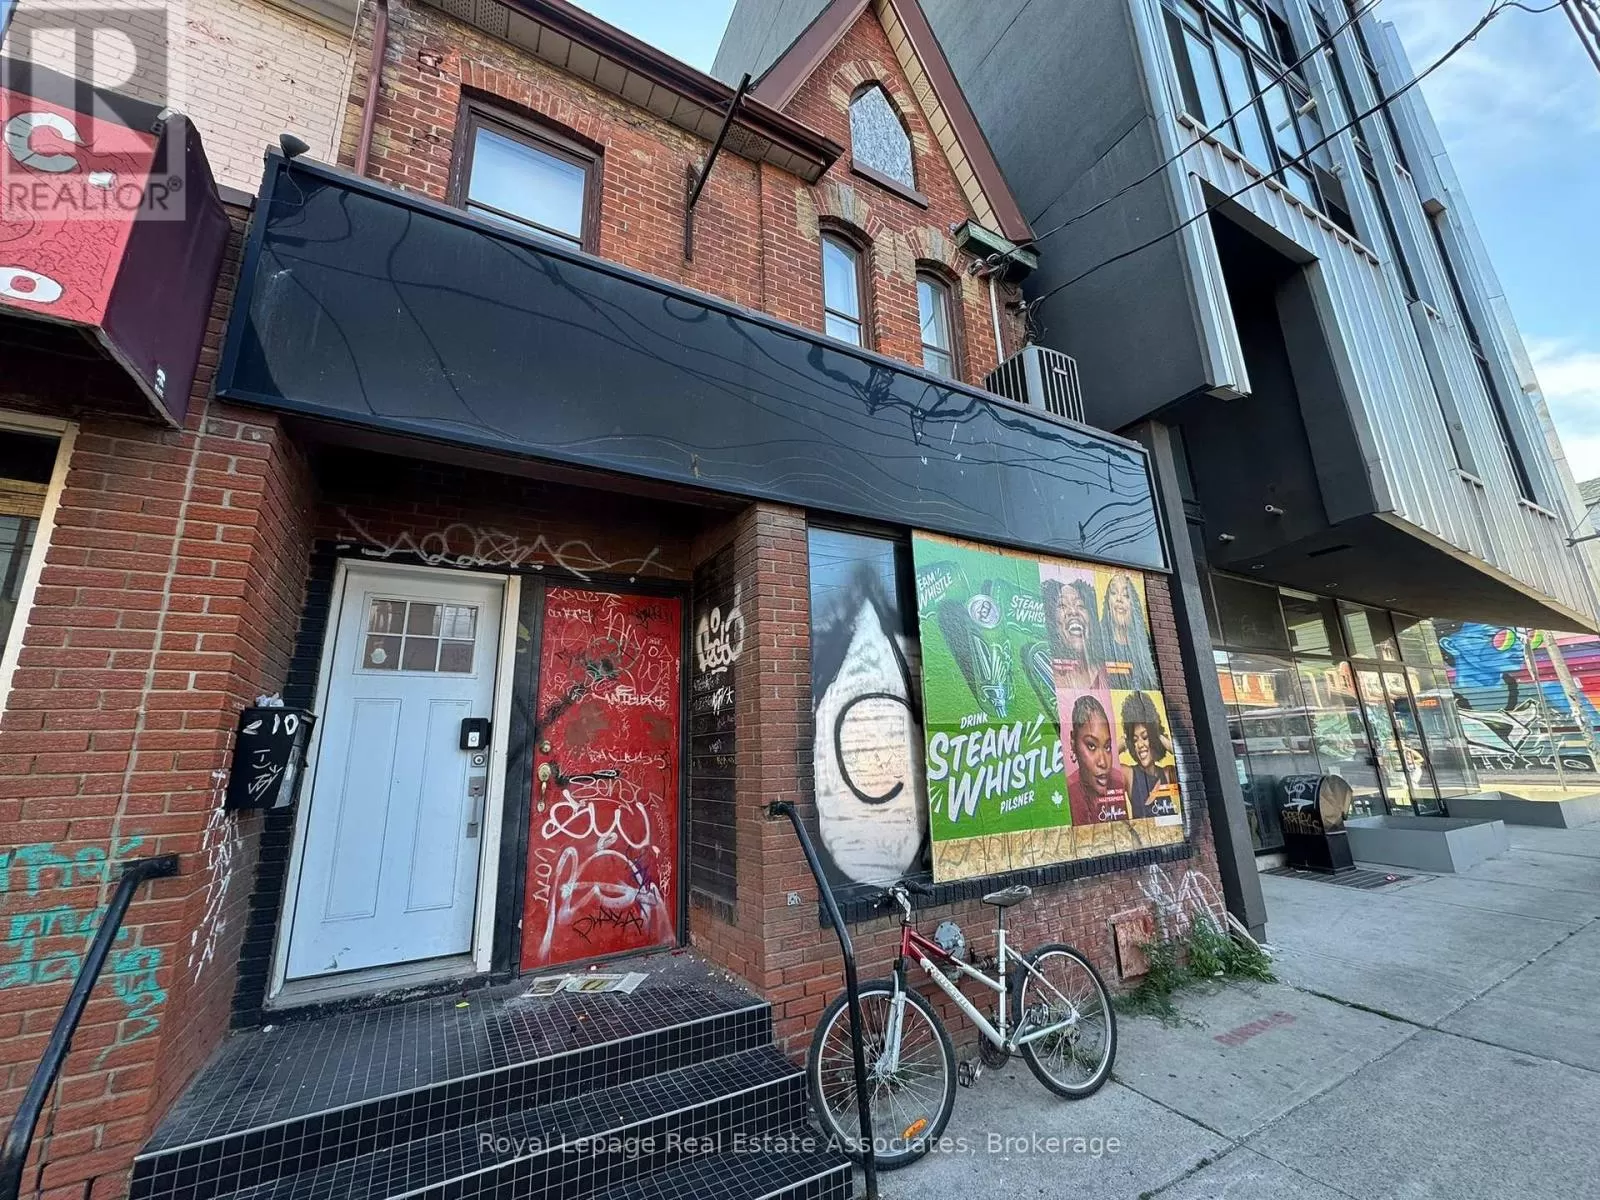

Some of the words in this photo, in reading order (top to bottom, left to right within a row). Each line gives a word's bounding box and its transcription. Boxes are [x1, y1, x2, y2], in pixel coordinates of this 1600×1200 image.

[918, 572, 954, 612] WHISTLE
[1010, 595, 1044, 612] STEAM
[960, 711, 988, 730] DRINK
[926, 720, 1023, 781] STEAM
[948, 739, 1064, 823] WHISTLE
[1000, 790, 1035, 815] PILSNER
